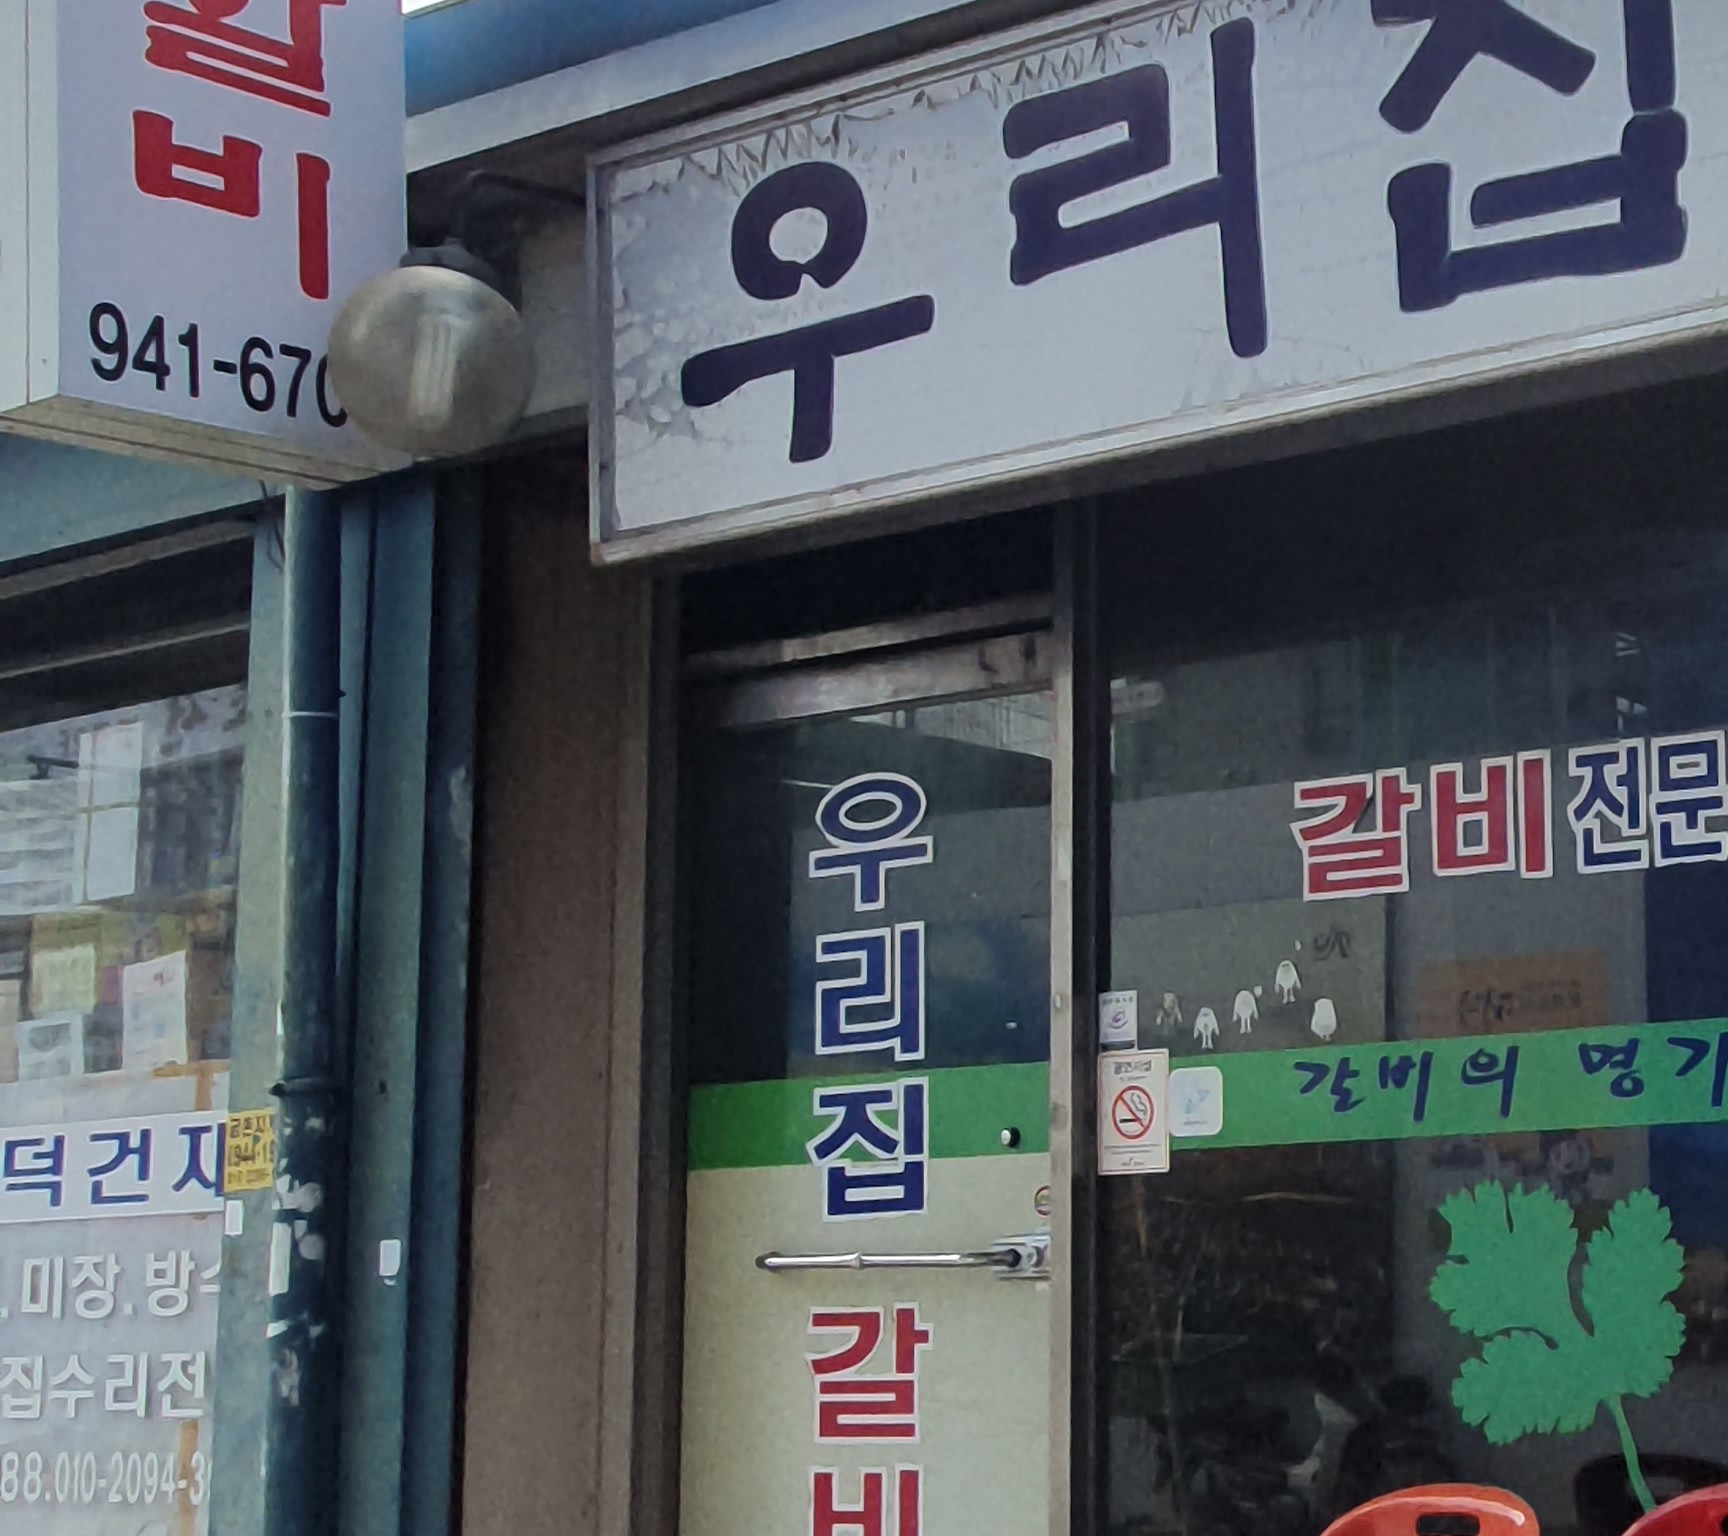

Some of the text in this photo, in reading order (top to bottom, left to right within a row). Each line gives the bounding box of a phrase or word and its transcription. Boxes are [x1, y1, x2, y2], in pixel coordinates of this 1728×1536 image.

[1289, 748, 1554, 902] 갈비
[807, 771, 934, 1224] 우리집
[1293, 1044, 1521, 1123] 갈비의
[0, 1449, 213, 1506] 88.010-2094-3
